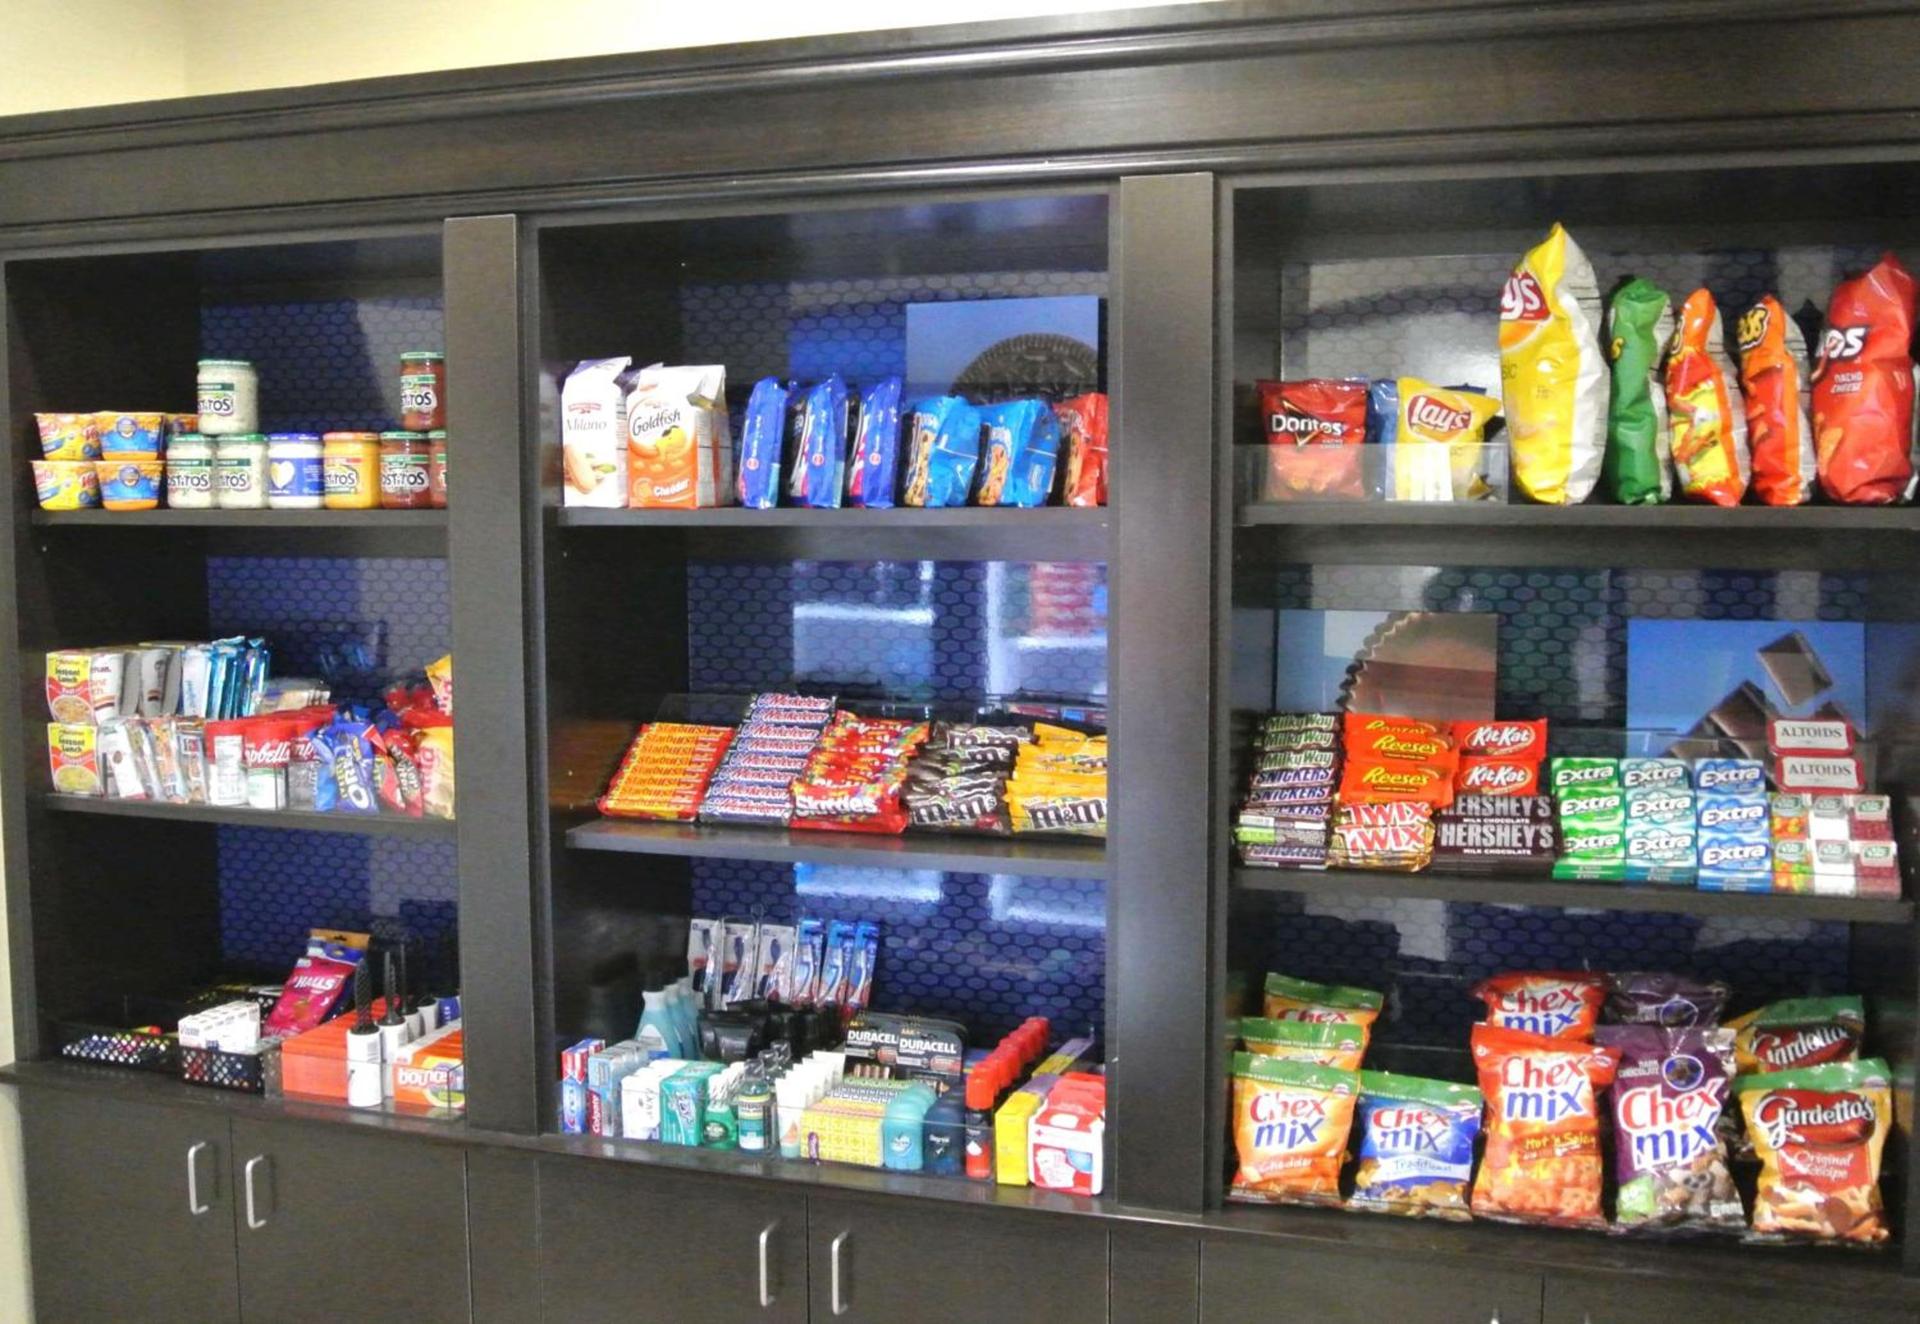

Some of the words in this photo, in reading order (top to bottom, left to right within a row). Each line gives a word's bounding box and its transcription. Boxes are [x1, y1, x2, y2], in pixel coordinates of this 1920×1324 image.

[632, 409, 681, 437] Goldfish
[1411, 395, 1472, 433] Lay's
[566, 418, 607, 432] Milano
[1271, 414, 1343, 436] Doritos
[653, 478, 690, 496] Cheddar
[1267, 715, 1304, 731] Milky
[1304, 713, 1335, 731] Way
[1781, 726, 1843, 738] ALTOIDS
[1264, 732, 1303, 750] Milky
[1303, 731, 1334, 747] Way
[1372, 734, 1438, 755] Reese's
[1263, 751, 1303, 770] Milky
[1303, 750, 1334, 768] Way
[1788, 763, 1852, 776] ALTOIDS
[1255, 768, 1332, 784] SNICKERS
[1362, 767, 1430, 786] Reese's
[1556, 766, 1614, 786] Extra
[1625, 765, 1684, 787] Extra
[1700, 767, 1760, 788] Extra
[1251, 787, 1328, 803] SNICKERS
[1560, 795, 1621, 816] Extra
[1342, 801, 1431, 825] TWIX
[1630, 796, 1692, 818] Extra
[1701, 805, 1764, 827] Extra
[1336, 825, 1426, 857] TWIX
[1440, 822, 1555, 849] HERSHEY'S
[1629, 834, 1693, 856] Extra
[1484, 848, 1532, 856] CHOCOLATE
[1702, 844, 1766, 865] Extra
[294, 976, 336, 990] HALLS
[1498, 985, 1584, 1013] Chex
[1502, 1004, 1580, 1036] mix
[900, 1038, 957, 1054] DURACELL
[397, 1069, 448, 1087] bounce
[1502, 1055, 1591, 1089] Chex
[1250, 1093, 1327, 1124] Chex
[1505, 1081, 1585, 1122] mix
[1620, 1078, 1726, 1132] Chex
[1372, 1104, 1450, 1129] Chex
[1754, 1094, 1876, 1149] Gardetto's
[1254, 1117, 1325, 1149] mix
[1379, 1124, 1448, 1152] mix
[1525, 1137, 1549, 1150] Hot
[1634, 1111, 1718, 1165] mix
[1257, 1157, 1313, 1173] Cheddar
[1793, 1150, 1854, 1168] Original
